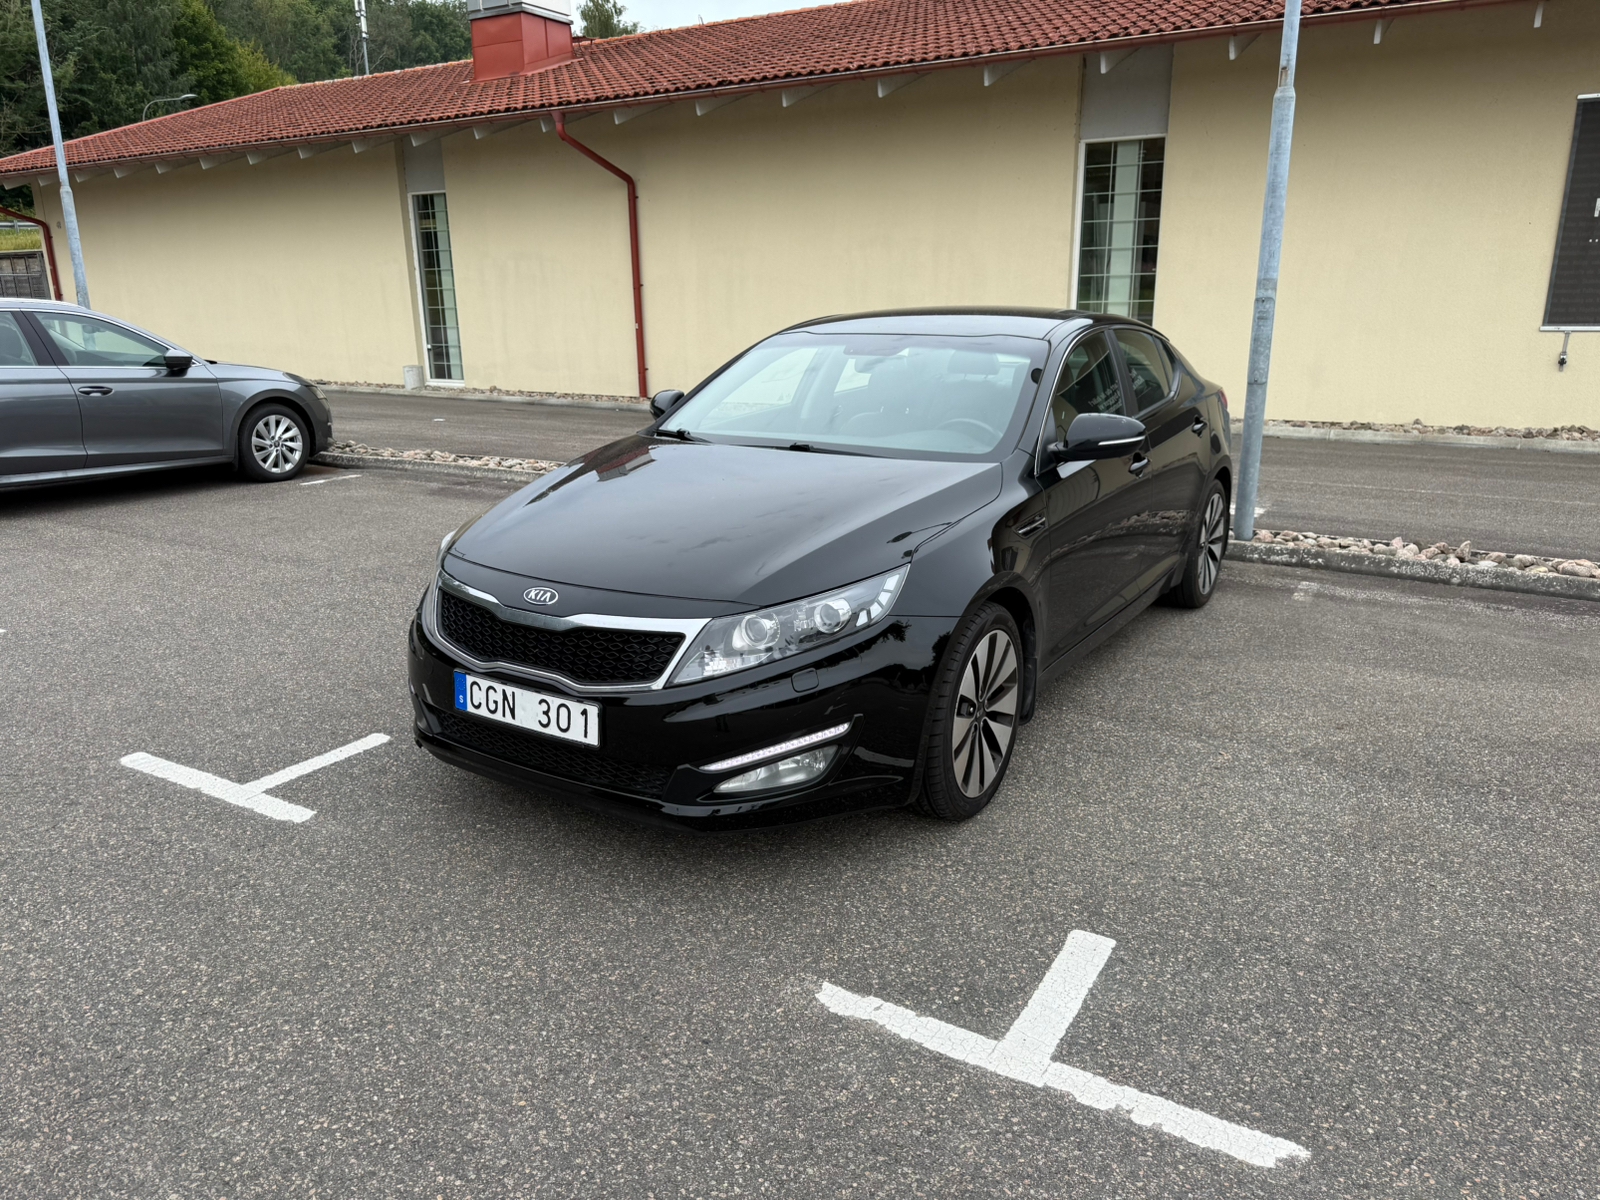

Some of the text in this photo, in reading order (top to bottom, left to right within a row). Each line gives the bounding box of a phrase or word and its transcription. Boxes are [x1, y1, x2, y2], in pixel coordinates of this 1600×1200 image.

[527, 588, 552, 603] KIA
[459, 694, 464, 704] S
[469, 681, 589, 739] CGN 301
